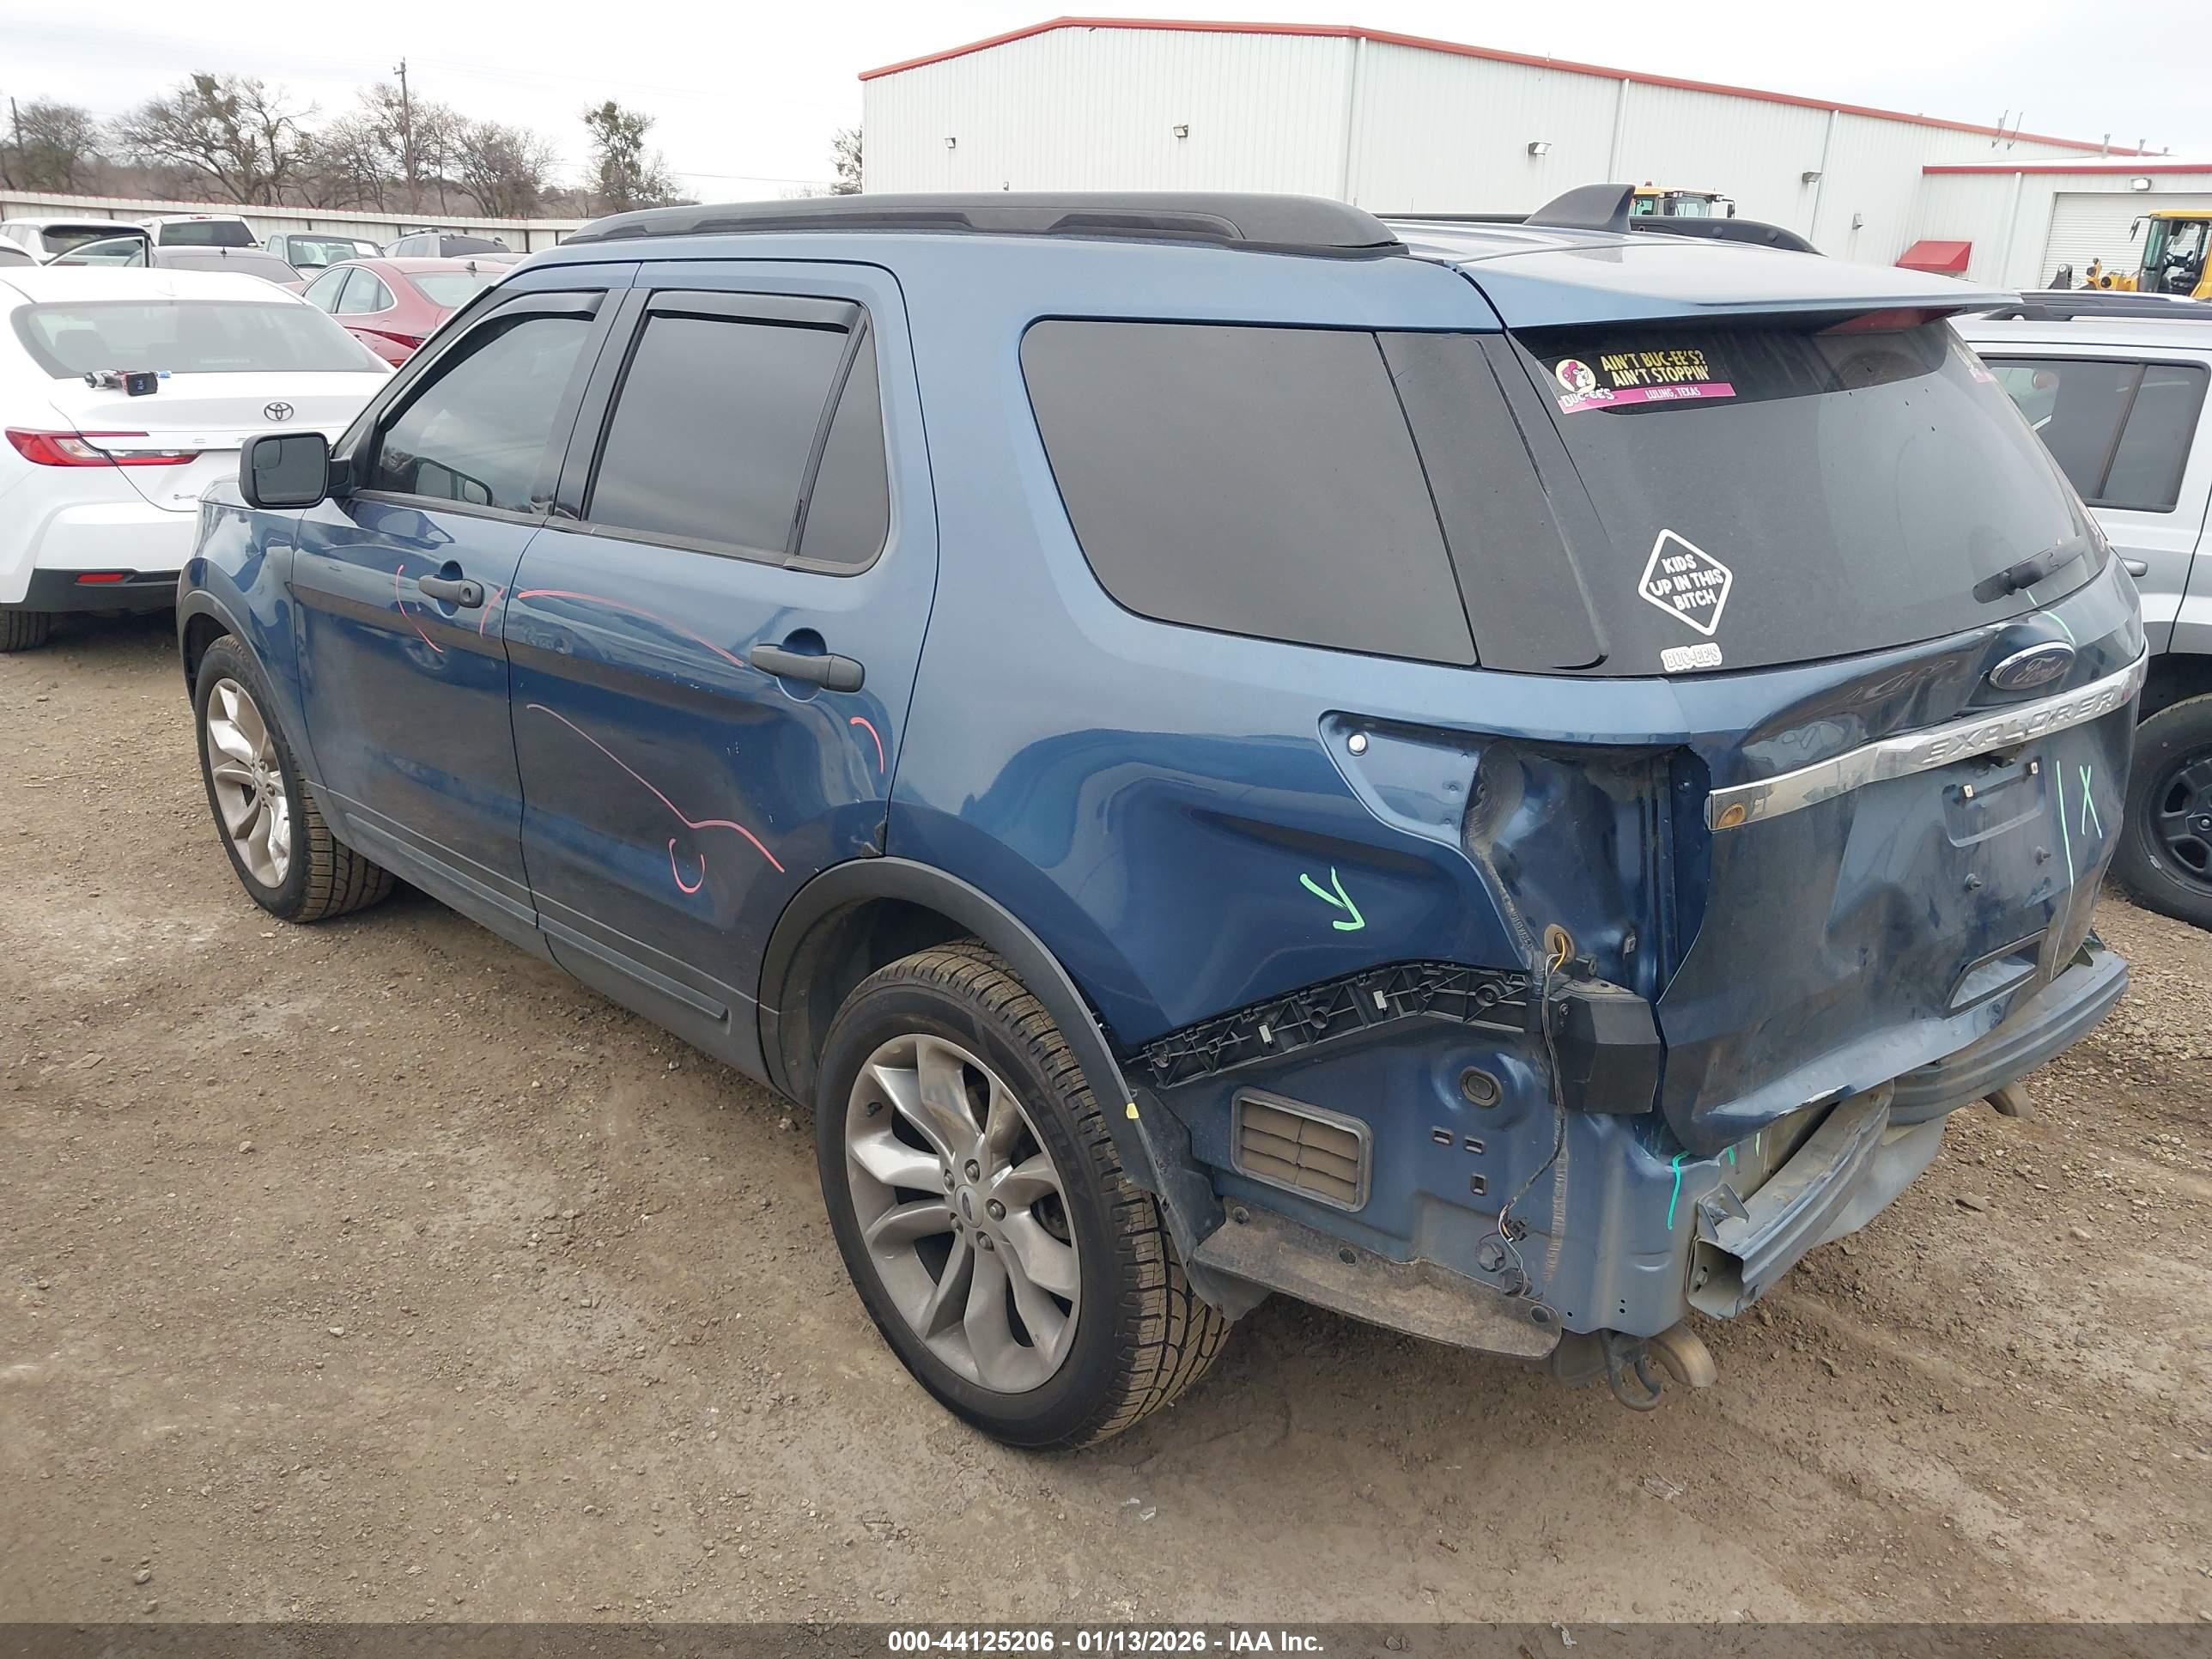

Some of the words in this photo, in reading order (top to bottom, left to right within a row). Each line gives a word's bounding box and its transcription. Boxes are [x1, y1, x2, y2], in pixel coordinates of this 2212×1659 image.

[1600, 354, 1638, 372] AIN'T
[1640, 349, 1706, 368] BUC-EE'S?
[1611, 368, 1650, 386] AIN'T
[1650, 364, 1710, 384] STOPPIN'
[1676, 386, 1701, 398] TEXAS
[1662, 554, 1697, 574] KIDS
[1649, 579, 1673, 597] UP
[1673, 574, 1692, 592] IN
[1691, 568, 1724, 587] THIS
[1673, 588, 1717, 611] BITCH
[2011, 656, 2063, 685] Ford
[1921, 690, 2116, 764] EXPLORER
